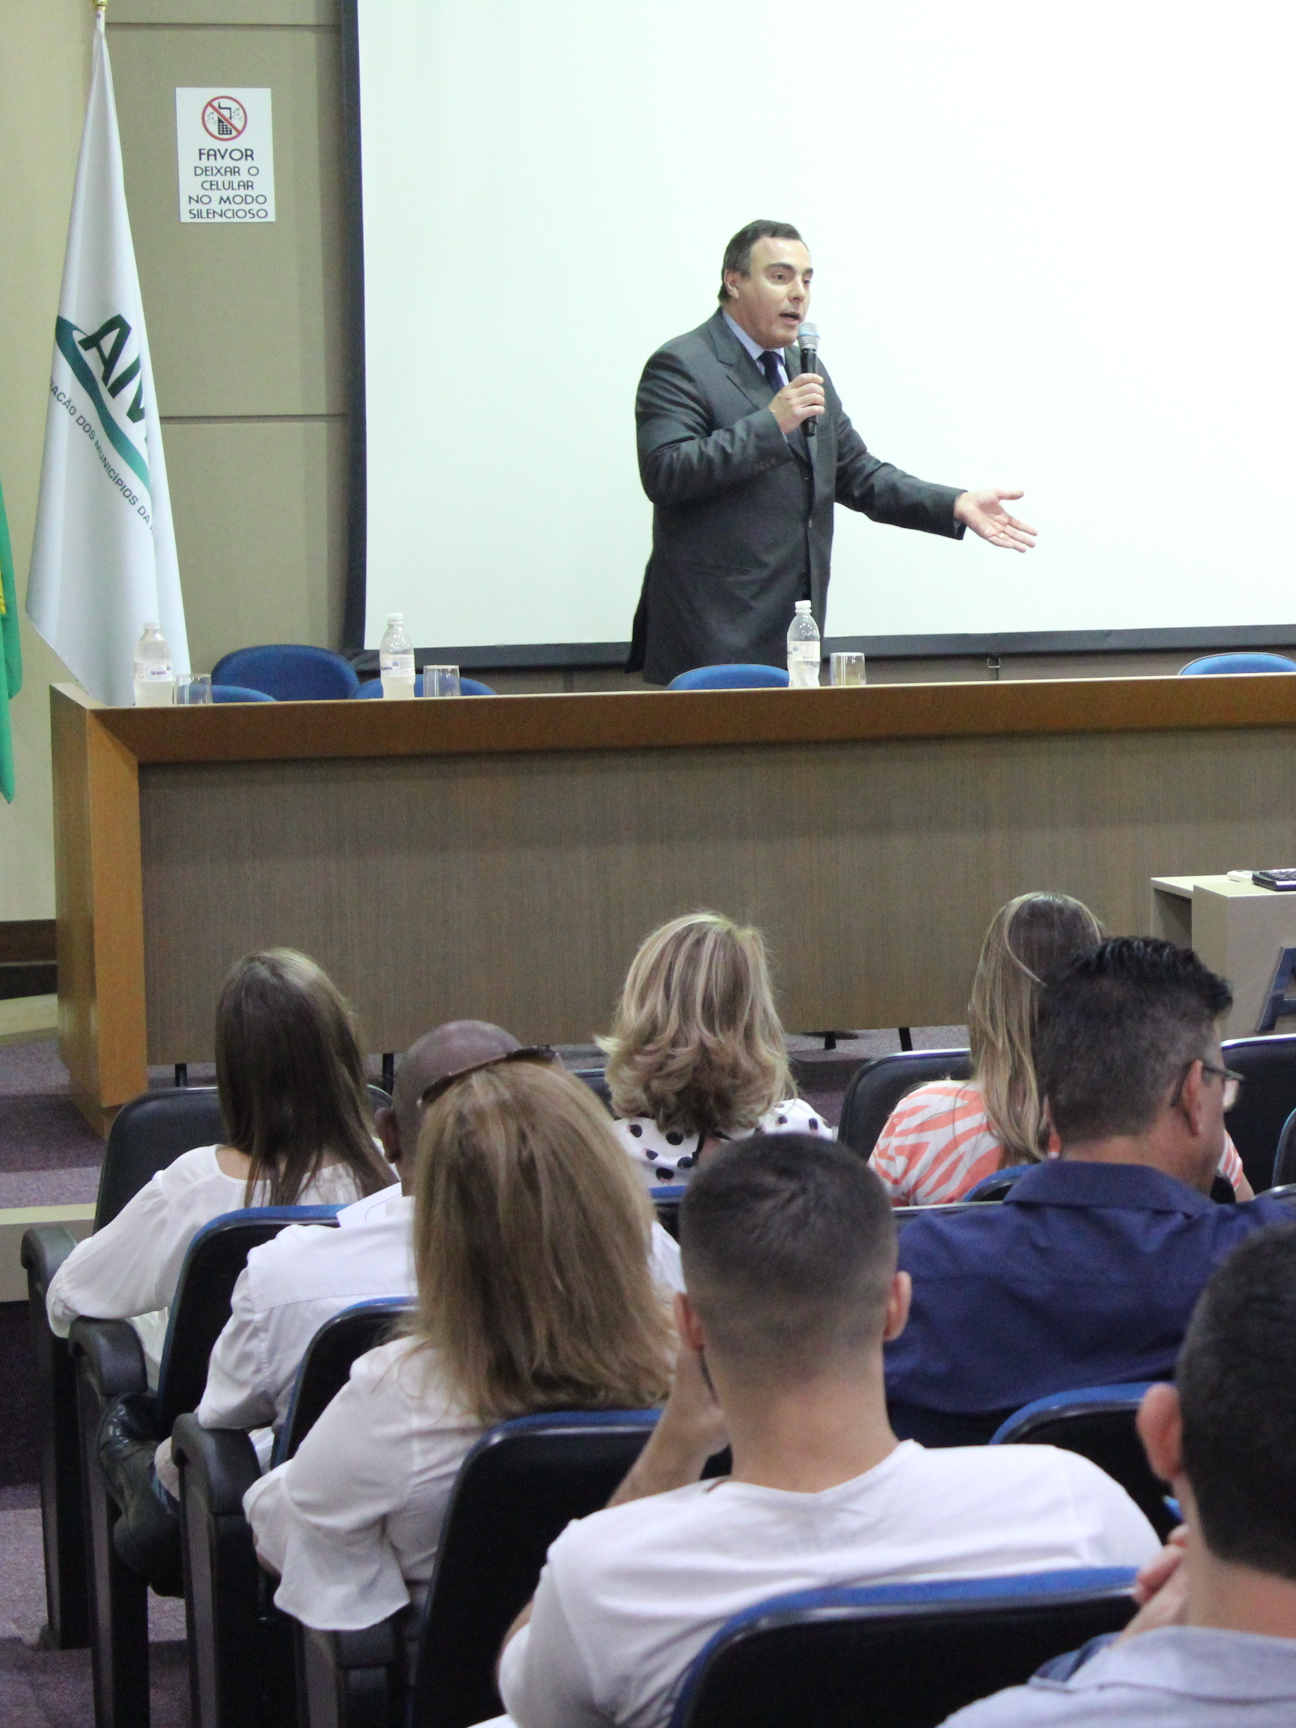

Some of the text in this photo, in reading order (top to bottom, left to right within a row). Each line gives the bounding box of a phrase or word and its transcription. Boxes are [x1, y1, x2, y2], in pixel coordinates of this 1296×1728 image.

[198, 148, 255, 162] FAVOR
[194, 166, 260, 177] DEIXAR O
[201, 180, 254, 191] CELULAR
[188, 194, 267, 205] NO MODO
[188, 208, 268, 219] SILENCIOSO
[76, 414, 96, 440] DOS
[94, 438, 139, 507] MUNICÍPIOS
[137, 505, 151, 525] DA
